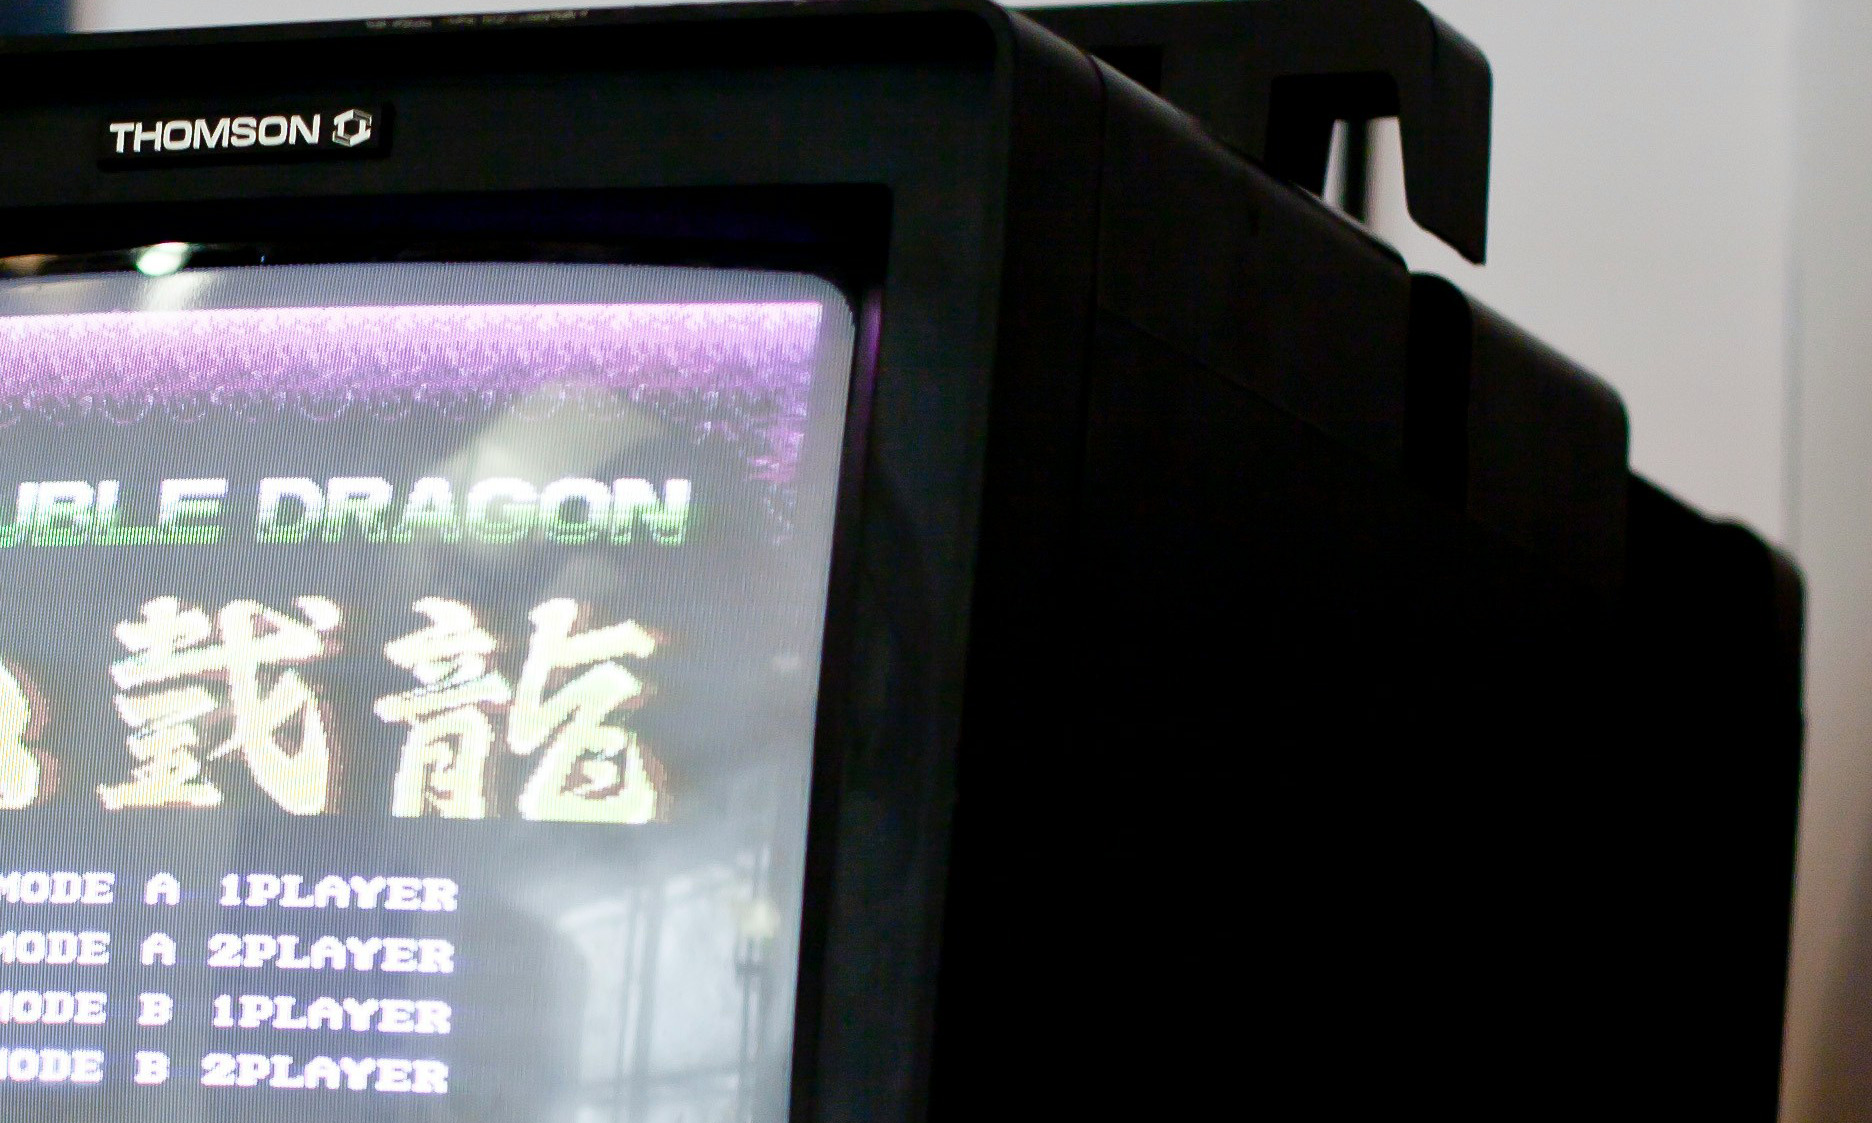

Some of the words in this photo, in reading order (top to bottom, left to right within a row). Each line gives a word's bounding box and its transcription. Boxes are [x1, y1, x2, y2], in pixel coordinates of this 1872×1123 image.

[109, 114, 321, 153] THOMSON
[256, 477, 692, 545] DRAGON
[145, 872, 180, 905] A
[219, 873, 459, 911] 1PLAYER
[141, 931, 176, 966] A
[207, 933, 456, 974] 2PLAYER
[138, 992, 173, 1026] B
[213, 994, 452, 1034] 1PLAYER
[134, 1050, 169, 1084] B
[200, 1053, 449, 1093] 2PLAYER
